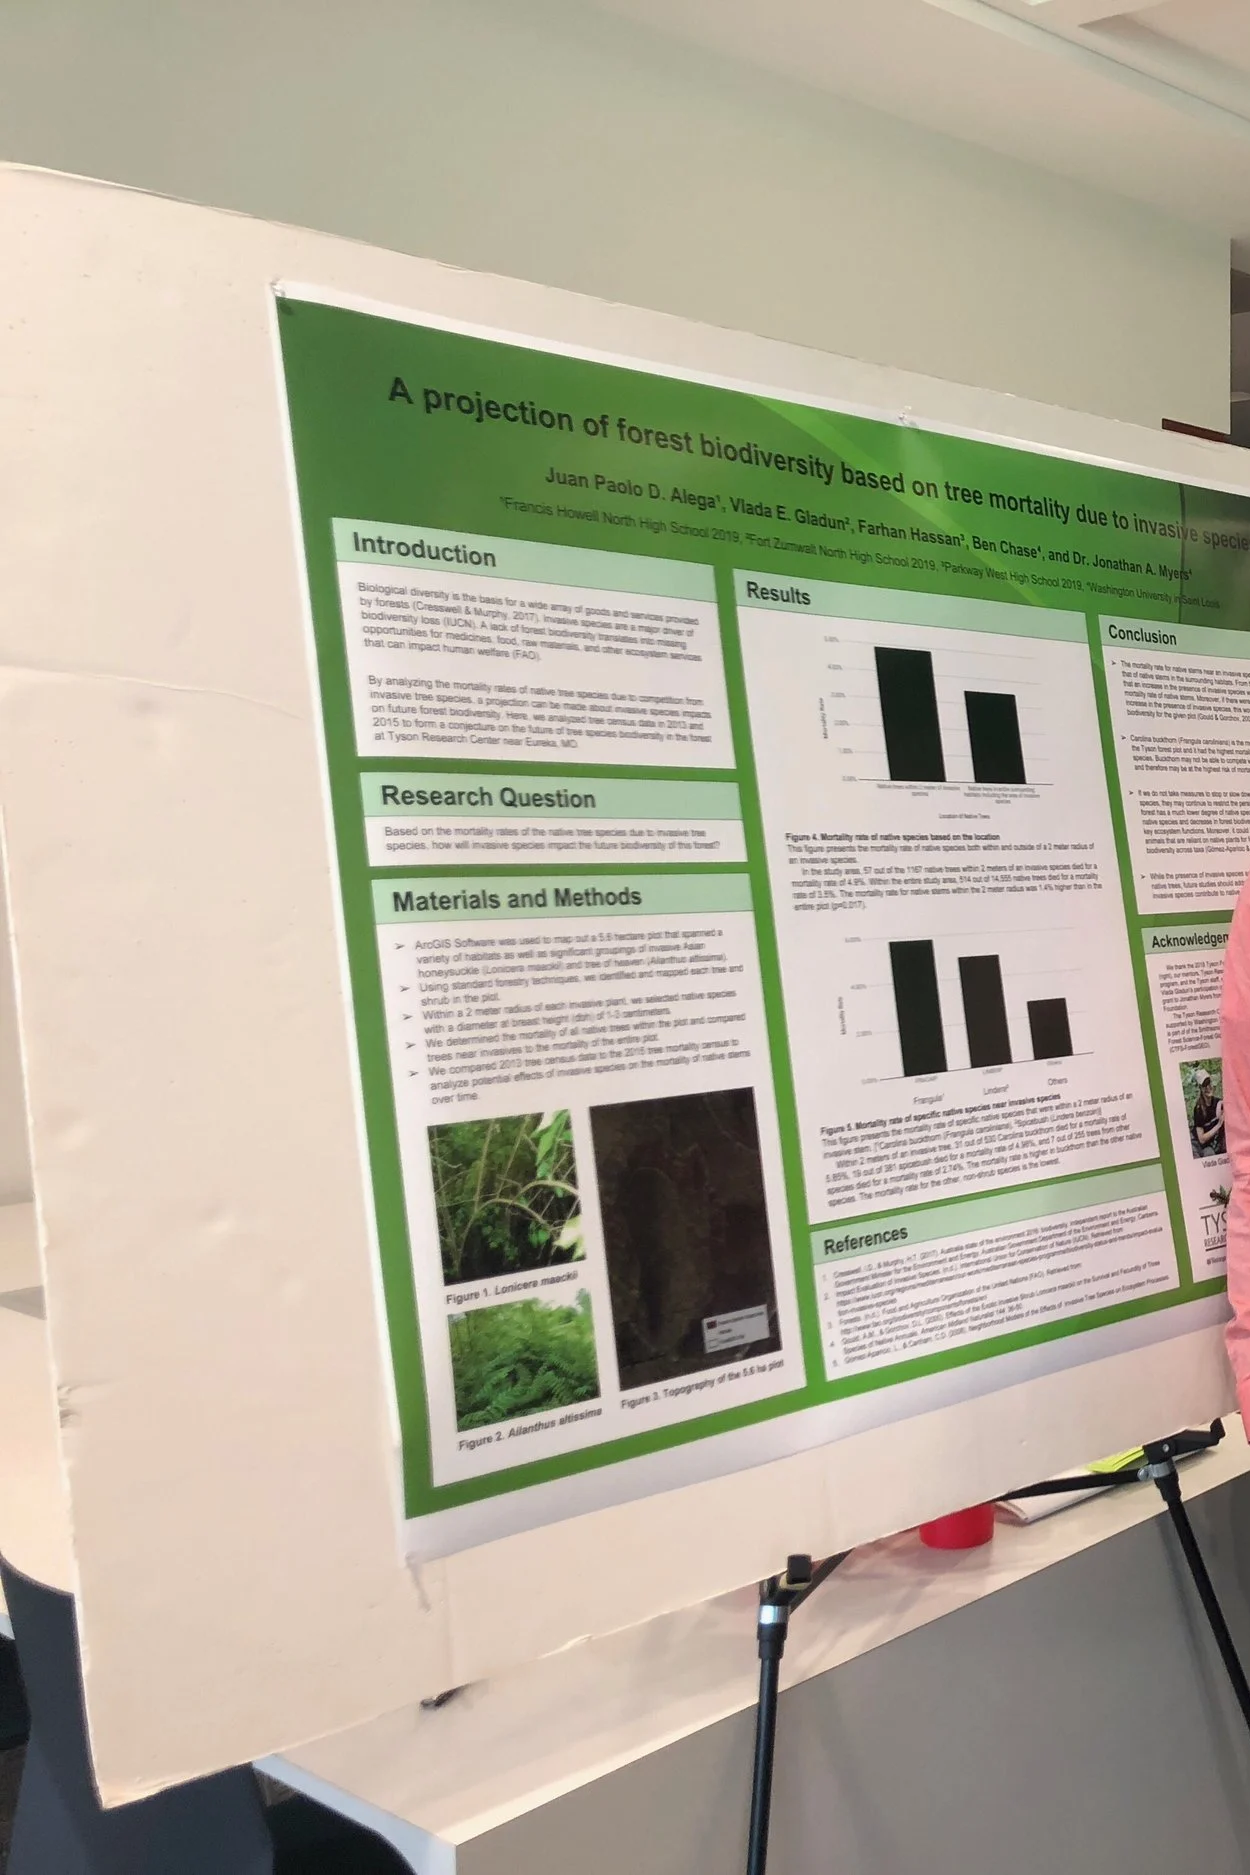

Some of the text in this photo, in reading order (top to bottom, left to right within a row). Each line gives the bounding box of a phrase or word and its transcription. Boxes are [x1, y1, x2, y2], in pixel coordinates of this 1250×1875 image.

[388, 376, 414, 404] A
[422, 387, 573, 432] projection
[582, 413, 609, 438] of
[616, 416, 694, 454] forest
[699, 432, 834, 485] biodiversity
[840, 460, 905, 497] based
[911, 479, 939, 498] on
[943, 480, 983, 505] tree
[988, 491, 1070, 525] mortality
[1075, 503, 1108, 526] due
[1111, 509, 1129, 530] to
[1132, 512, 1198, 547] invasive
[544, 466, 589, 488] Juan
[593, 473, 643, 496] Paolo
[647, 482, 665, 500] D.
[728, 496, 772, 518] Vlada
[775, 504, 791, 521] E.
[856, 518, 907, 540] Farhan
[971, 534, 997, 552] Ben
[1047, 549, 1070, 563] and
[1071, 550, 1089, 568] Dr.
[1091, 553, 1142, 574] Jonathan
[1144, 562, 1156, 575] A.
[352, 531, 496, 567] Introduction
[556, 504, 599, 522] Howell
[601, 511, 636, 527] North
[638, 516, 667, 534] High
[669, 520, 709, 538] School
[818, 544, 847, 558] North
[848, 548, 875, 564] High
[873, 552, 908, 568] School
[984, 566, 1010, 585] West
[1008, 568, 1030, 585] High
[1029, 573, 1060, 587] School
[1134, 587, 1172, 604] University
[357, 581, 408, 596] Biological
[409, 587, 450, 601] diversity
[460, 592, 477, 602] the
[503, 596, 517, 606] for
[746, 580, 811, 605] Results
[363, 637, 385, 648] that
[386, 640, 405, 649] can
[407, 640, 441, 652] impact
[441, 643, 475, 654] human
[1108, 623, 1177, 645] Conclusion
[386, 730, 419, 743] Tyson
[420, 731, 468, 743] Research
[380, 784, 596, 808] Research Question
[784, 832, 811, 843] Figure
[819, 832, 853, 842] Mortality
[870, 832, 878, 840] of
[878, 832, 901, 841] native
[901, 832, 929, 842] species
[929, 833, 951, 841] based
[392, 886, 642, 911] Materials and Methods
[823, 1226, 908, 1255] References
[445, 1290, 480, 1305] Figure
[494, 1279, 538, 1295] Lonicera
[458, 1435, 493, 1451] Figure
[507, 1419, 556, 1438] Ailanthus
[558, 1407, 602, 1425] altissima
